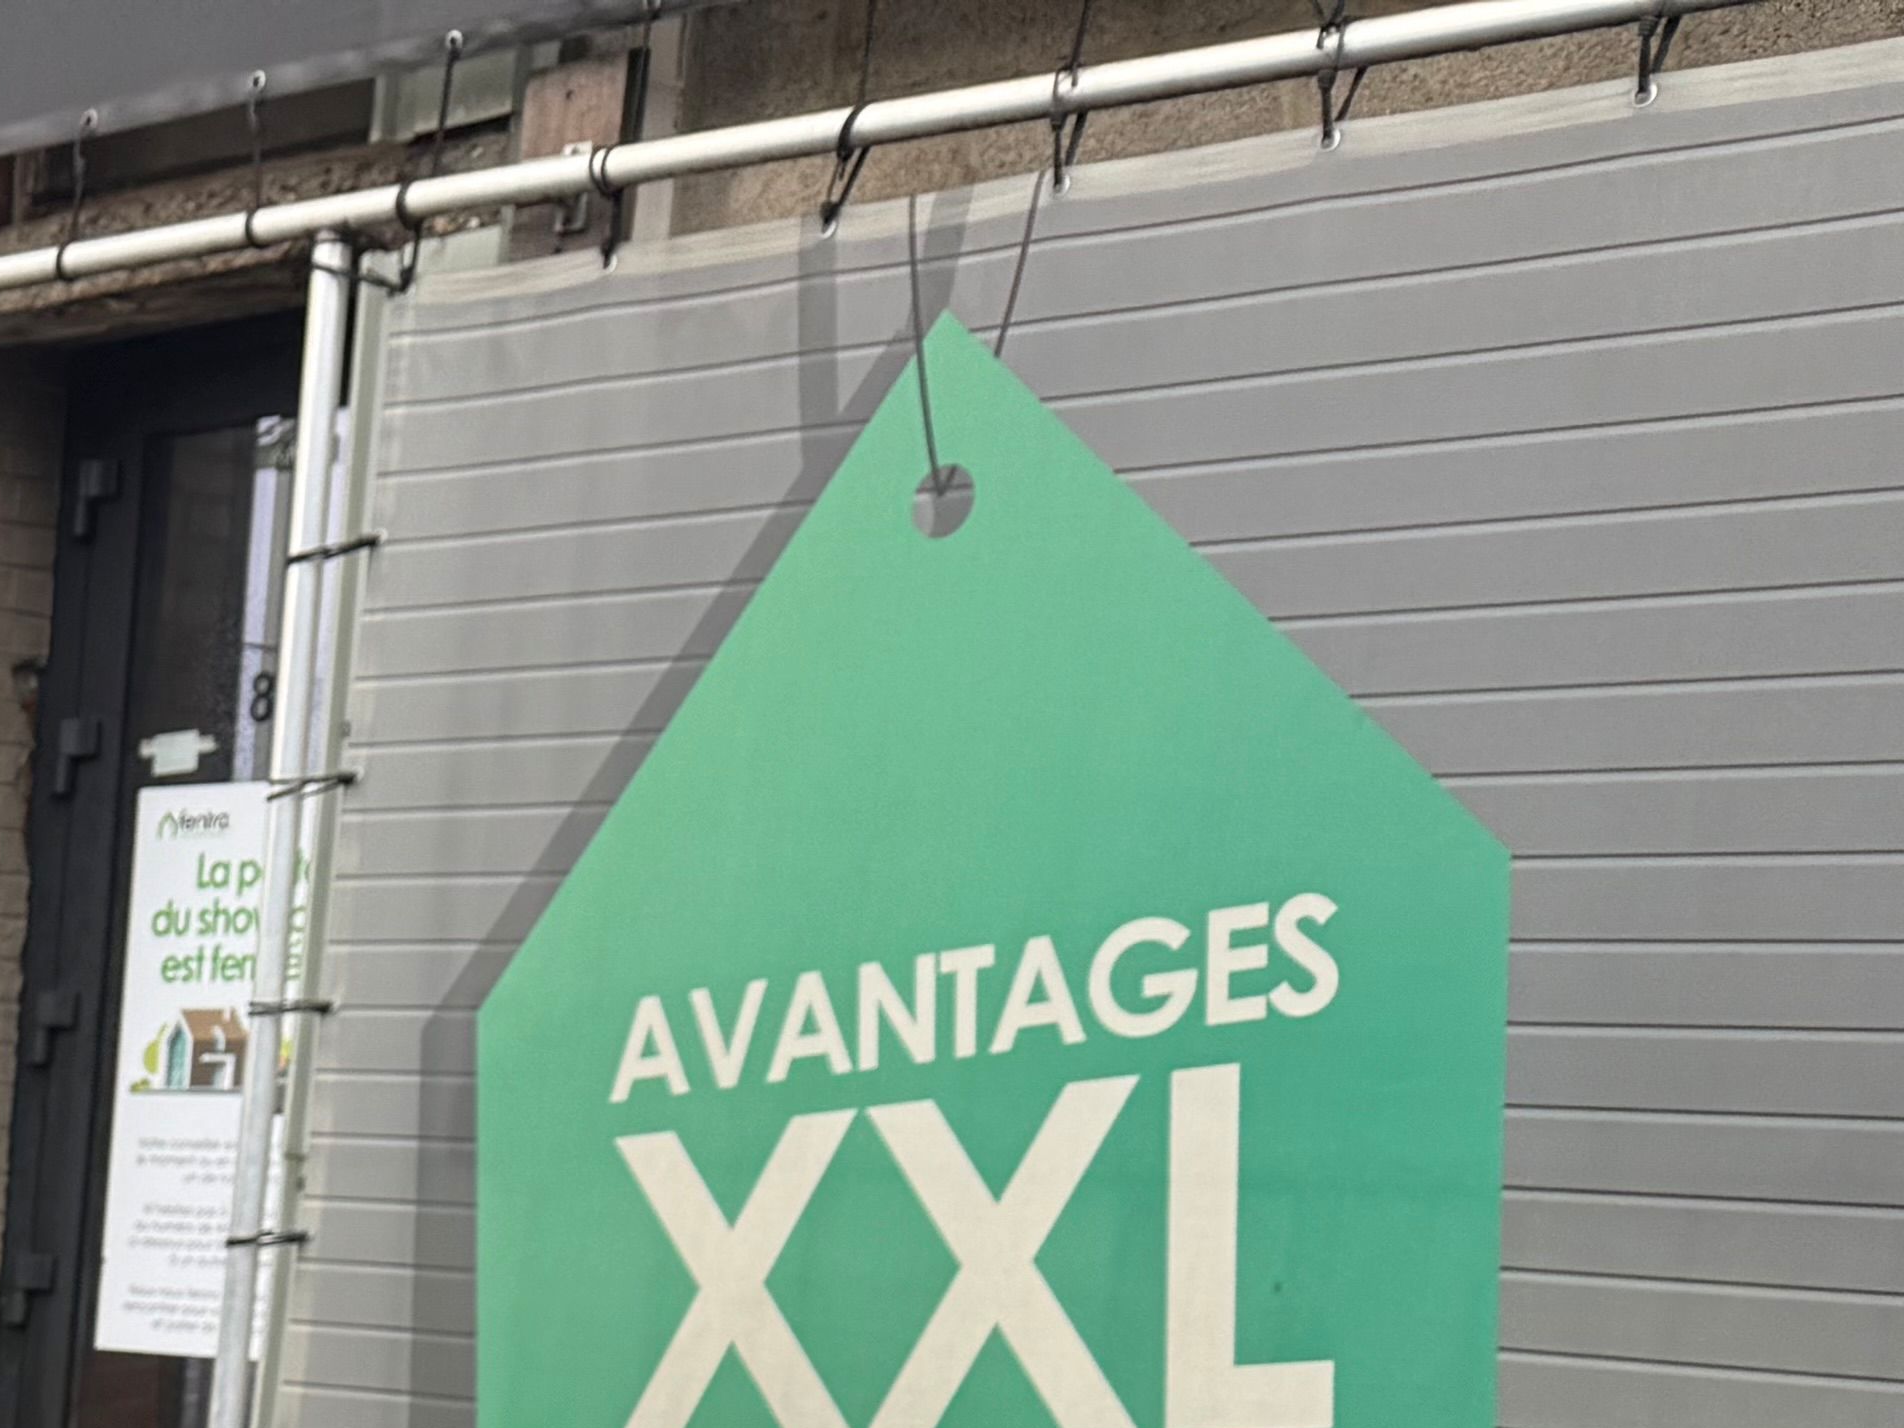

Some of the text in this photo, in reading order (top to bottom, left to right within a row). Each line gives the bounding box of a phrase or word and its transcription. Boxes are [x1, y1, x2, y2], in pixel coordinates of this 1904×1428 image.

[197, 852, 230, 889] La
[152, 899, 191, 936] du
[161, 944, 204, 983] est
[608, 892, 1340, 1104] AVANTAGES
